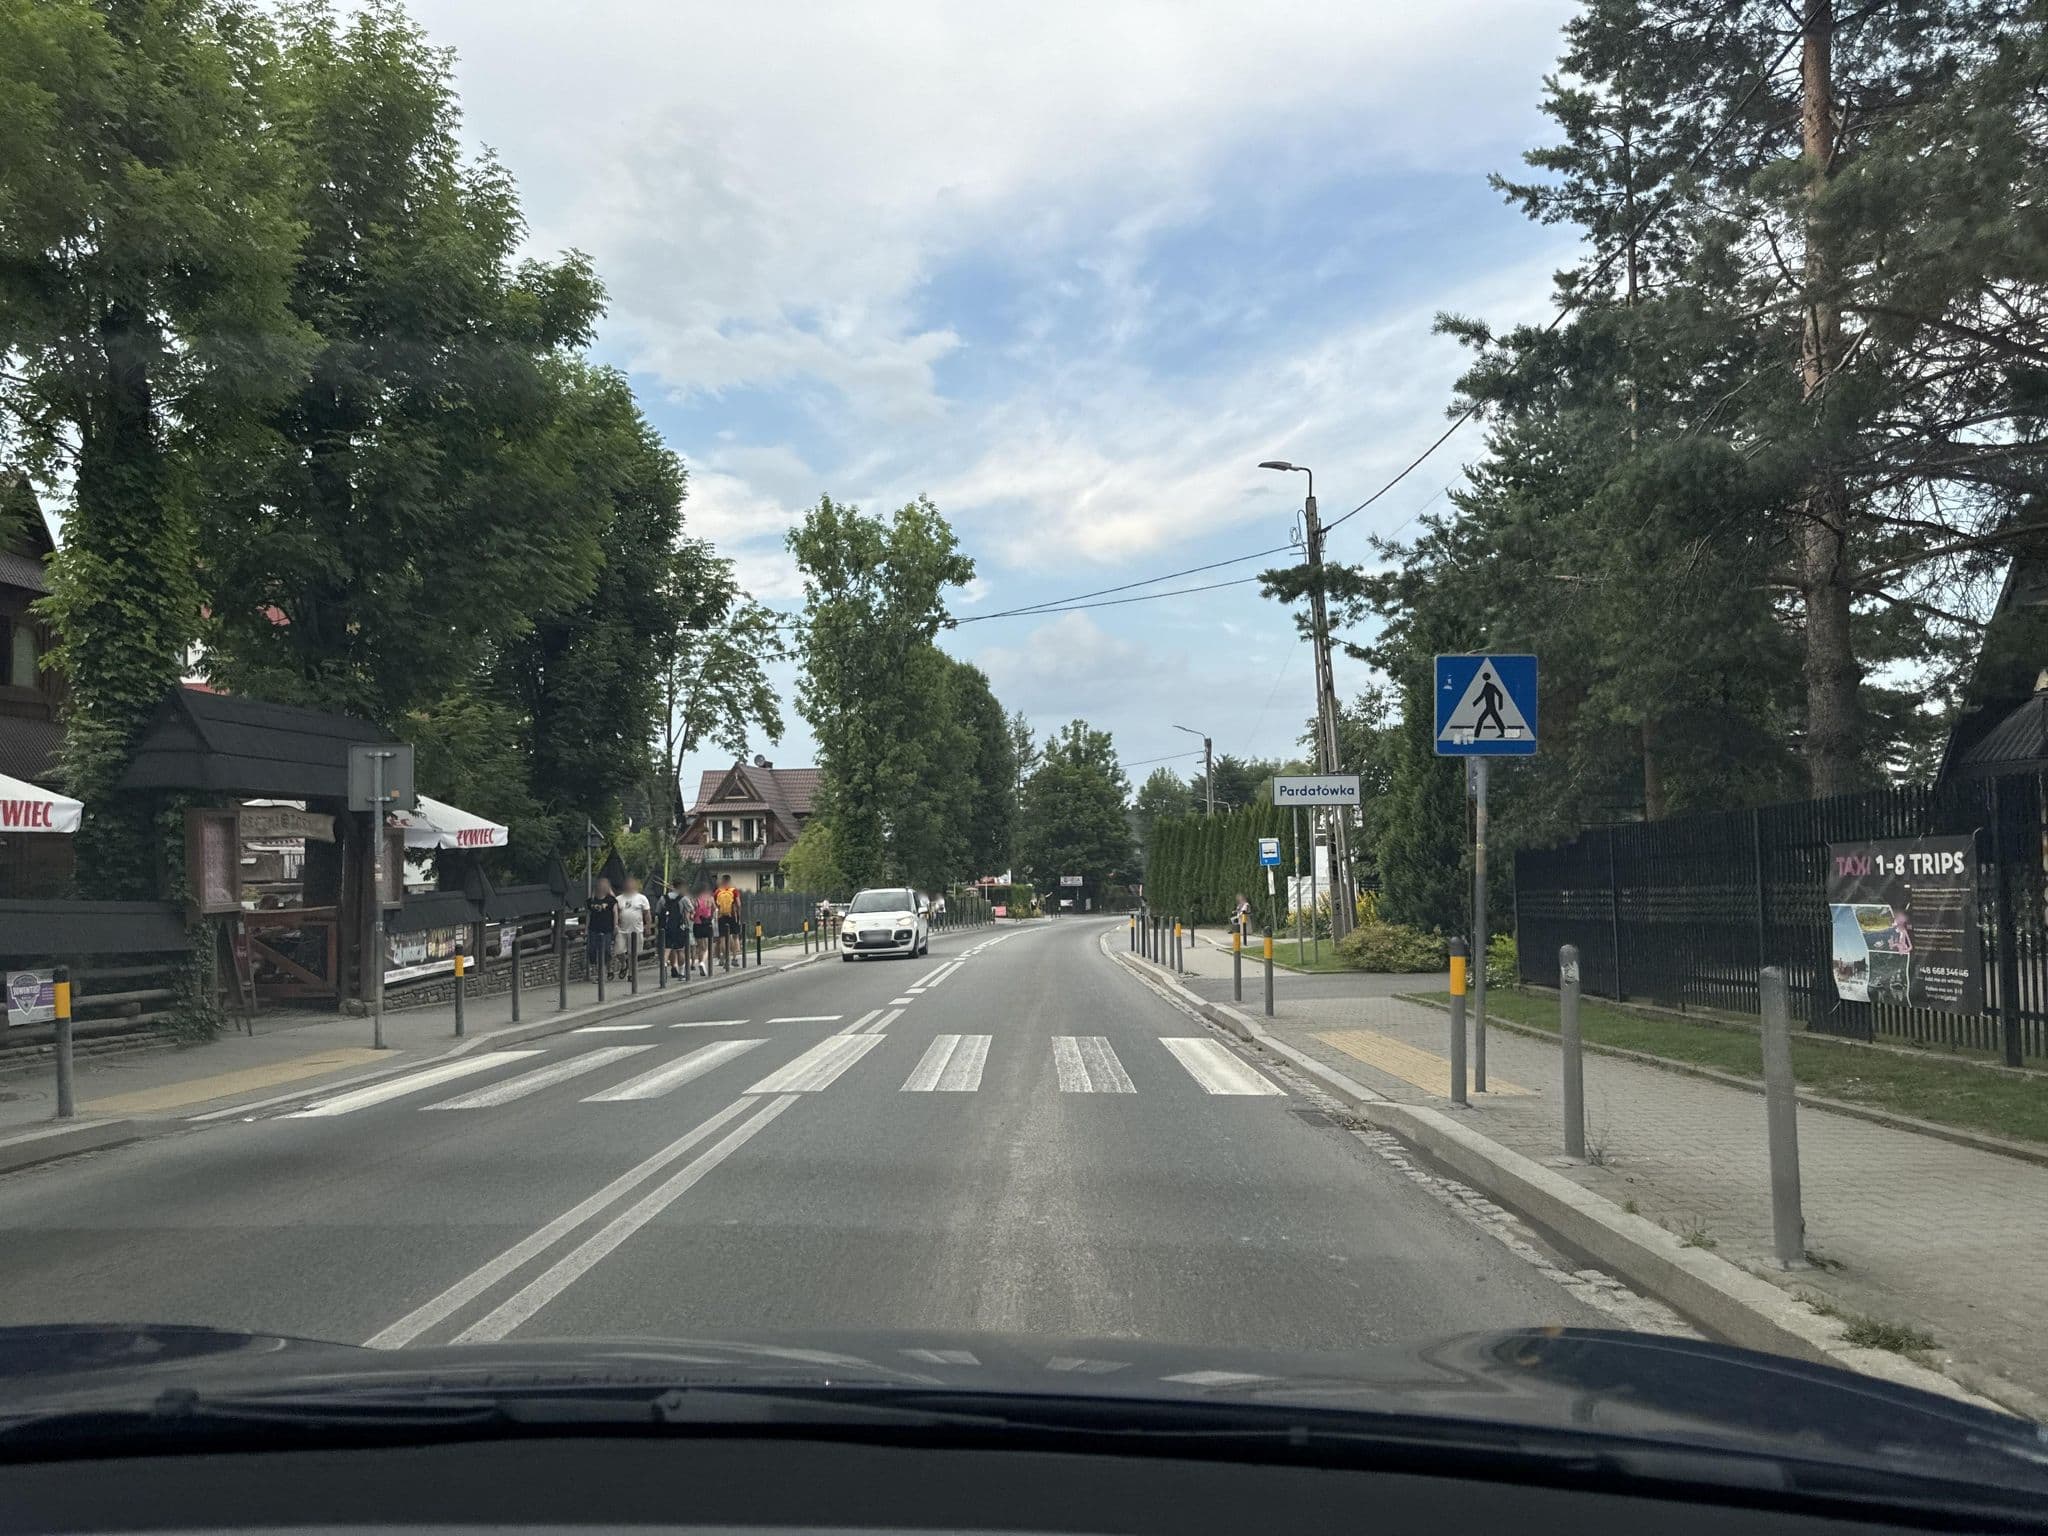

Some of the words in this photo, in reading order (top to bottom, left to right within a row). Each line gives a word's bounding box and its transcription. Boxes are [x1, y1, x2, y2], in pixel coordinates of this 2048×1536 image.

[1280, 785, 1355, 796] Pardałówka
[0, 800, 54, 827] WIEC
[1836, 856, 1871, 876] TAXI
[1875, 854, 1905, 875] 1-8
[1909, 851, 1965, 875] TRIPS
